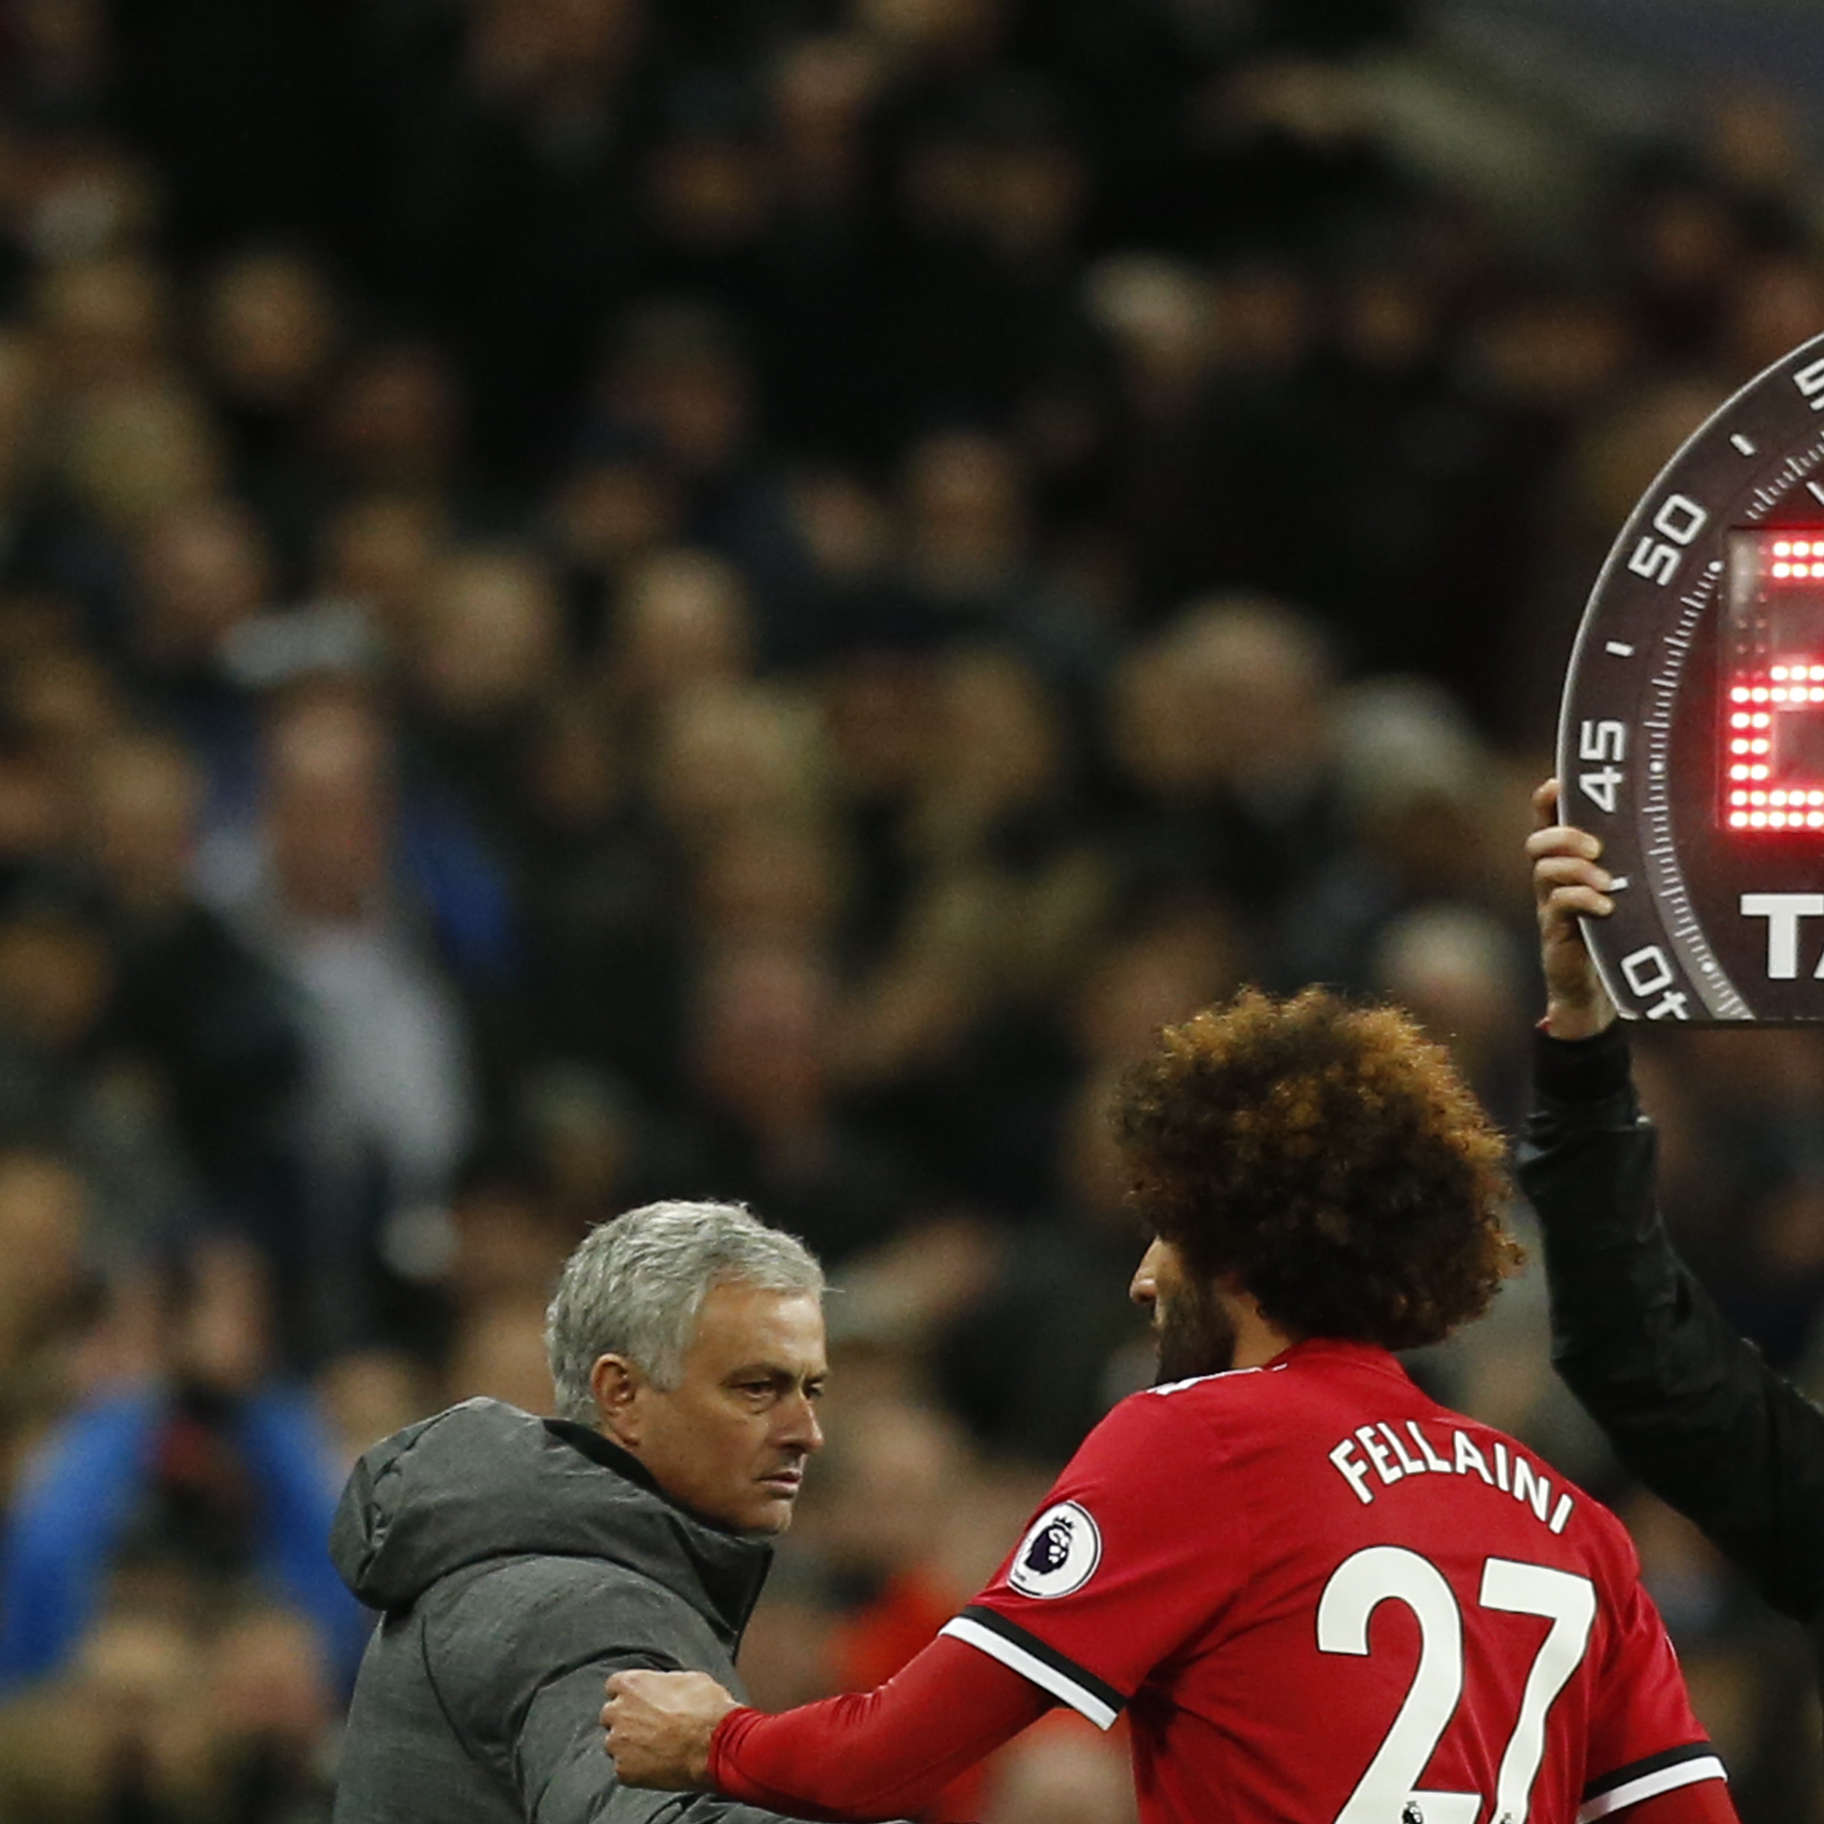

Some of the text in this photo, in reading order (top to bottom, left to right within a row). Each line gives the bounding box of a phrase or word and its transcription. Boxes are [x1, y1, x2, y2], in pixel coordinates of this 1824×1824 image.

[1629, 493, 1707, 585] 50
[1578, 717, 1627, 812] 45
[1329, 1420, 1574, 1535] FELLAINI
